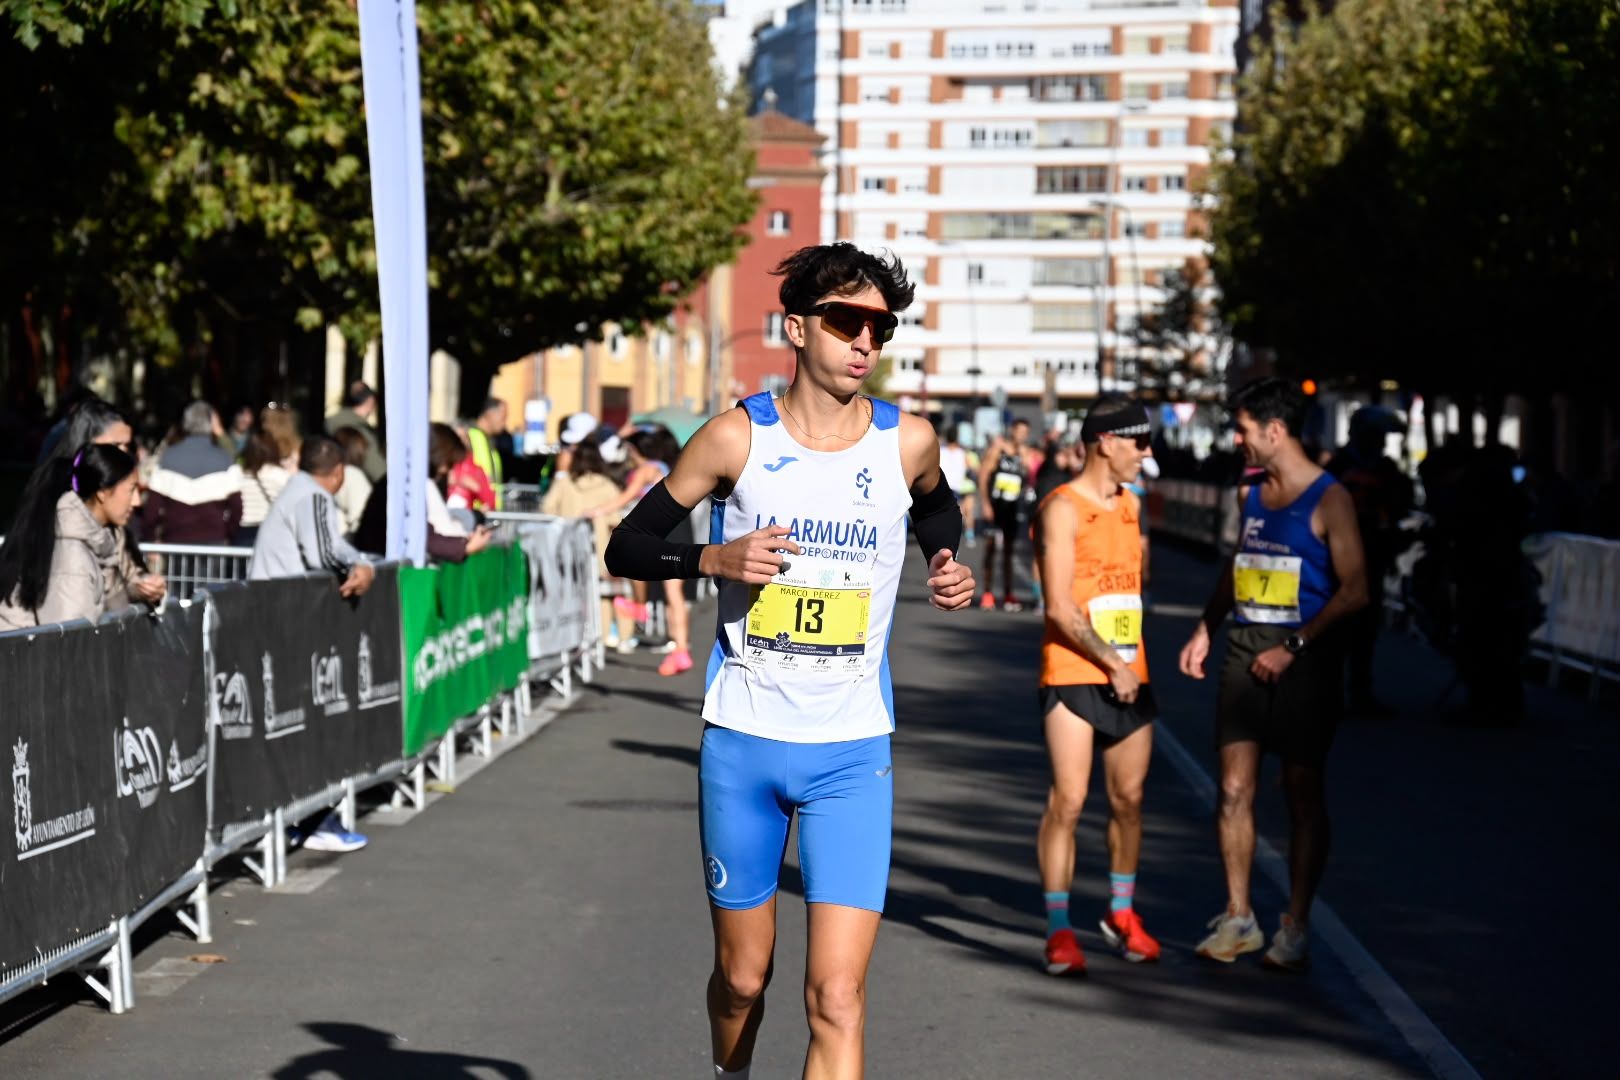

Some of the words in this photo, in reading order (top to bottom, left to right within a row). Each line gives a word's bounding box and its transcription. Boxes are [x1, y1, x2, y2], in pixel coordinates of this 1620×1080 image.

[786, 517, 877, 550] ARMUÑA
[780, 587, 808, 598] MARCO
[1260, 575, 1270, 597] 7
[794, 597, 825, 634] 13
[1115, 616, 1130, 637] 119
[33, 813, 75, 844] AYUNTAMIENTO
[75, 810, 82, 831] DE
